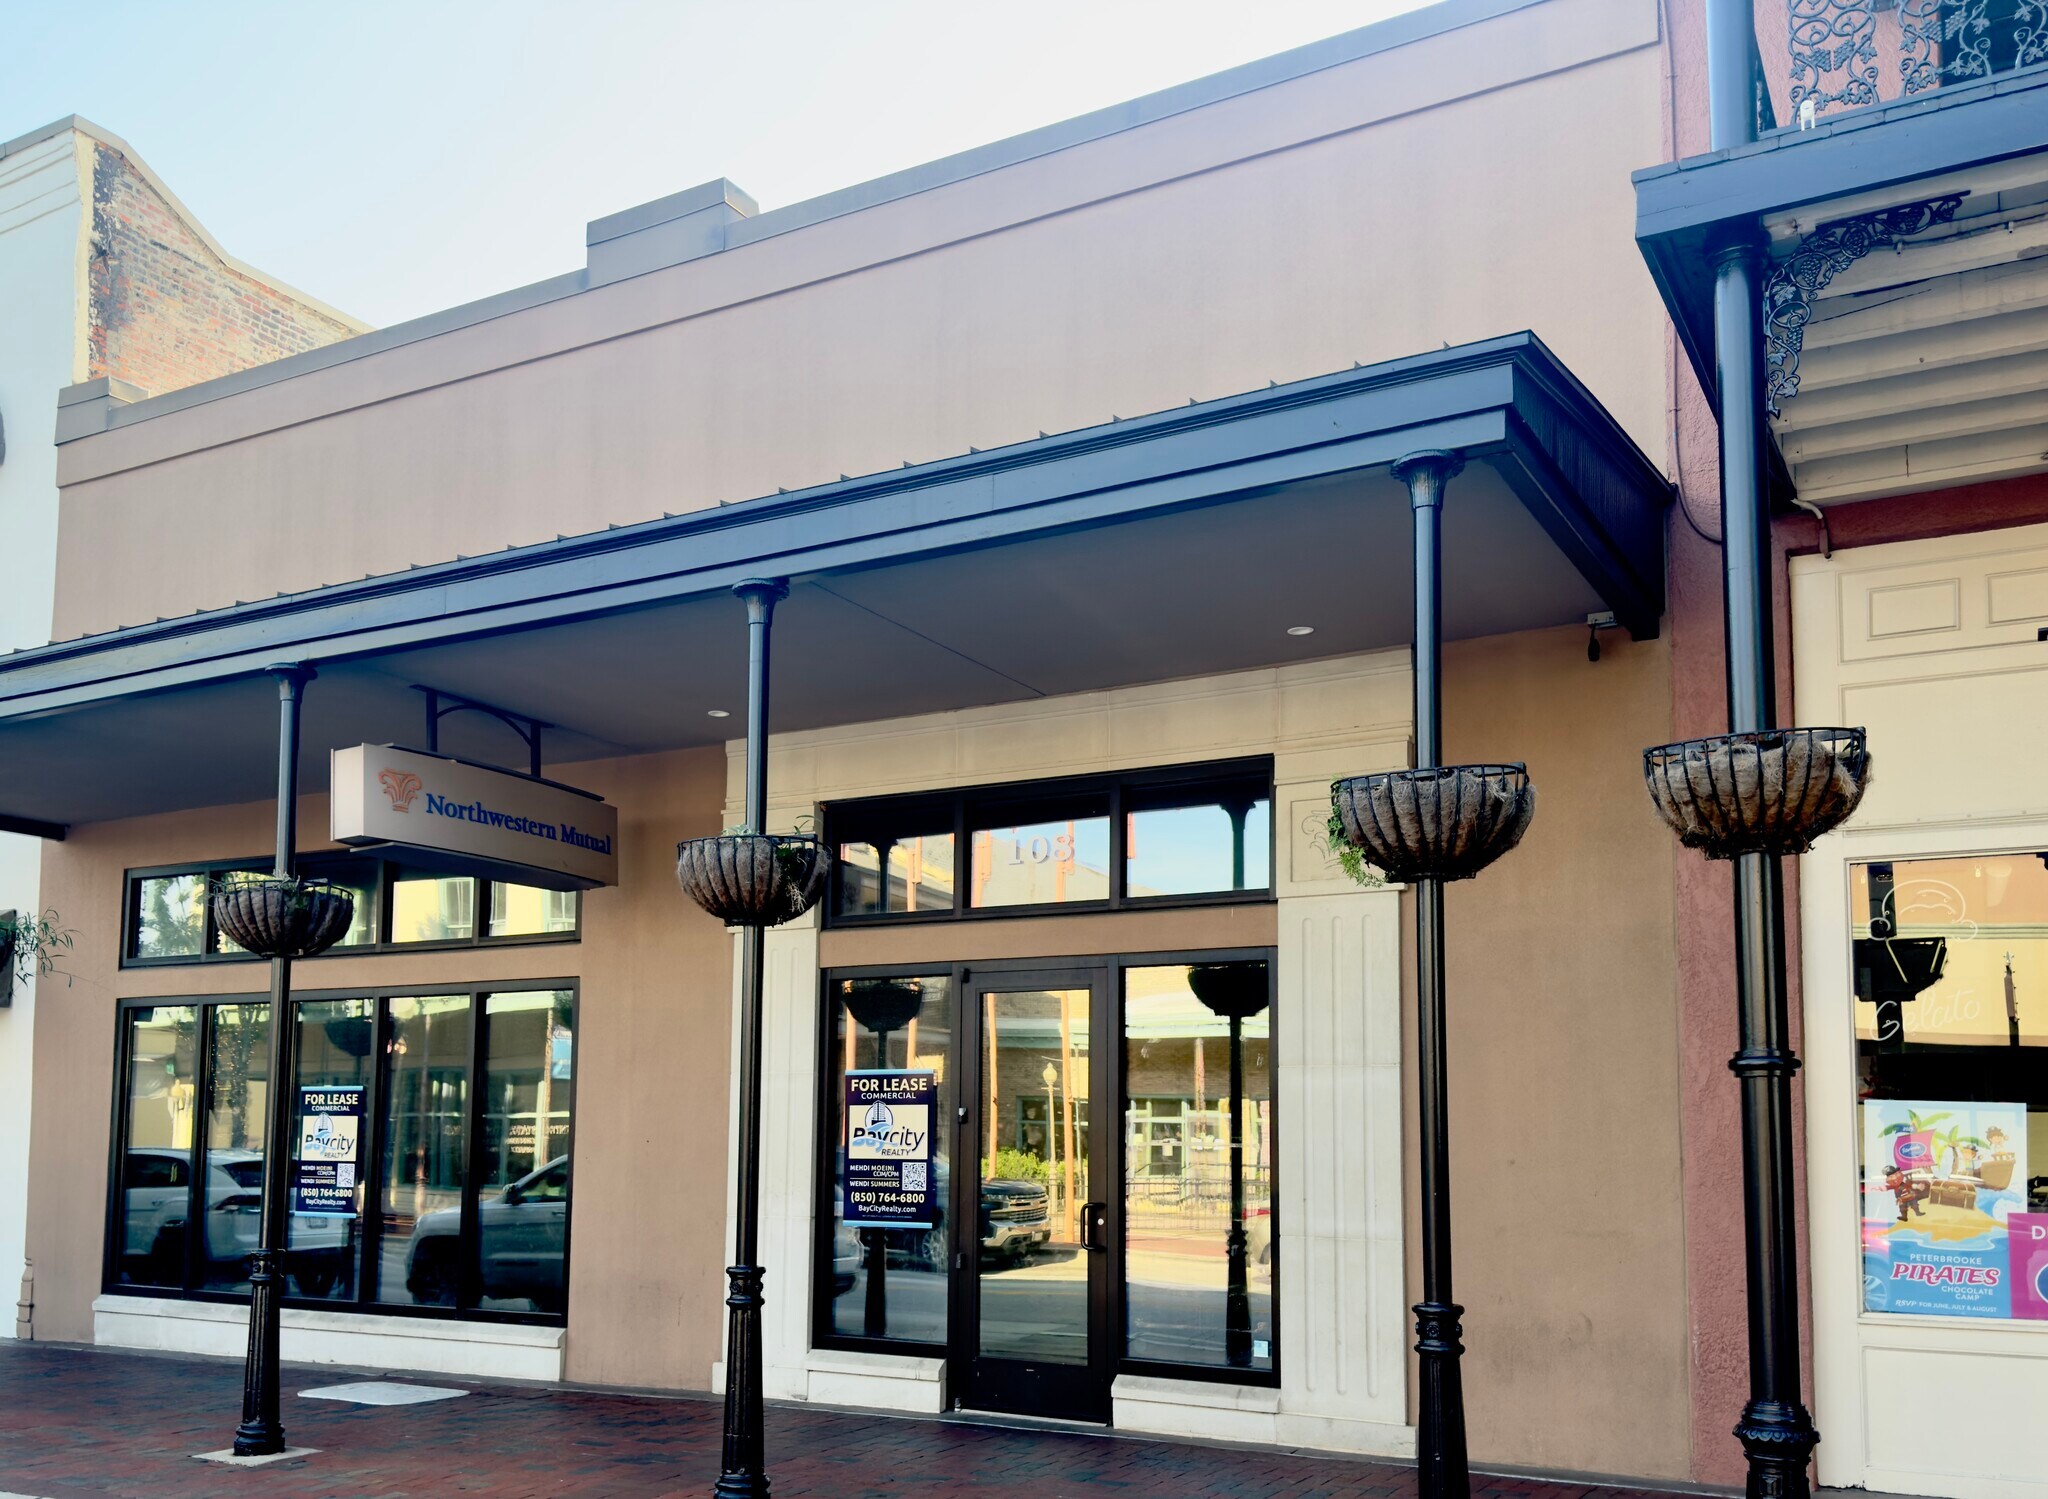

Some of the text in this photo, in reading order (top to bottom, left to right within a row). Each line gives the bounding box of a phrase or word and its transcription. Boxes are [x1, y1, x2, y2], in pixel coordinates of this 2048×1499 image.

[426, 793, 612, 856] Northwestern Mutual
[1008, 832, 1074, 865] 108
[1869, 988, 1980, 1041] Gelato
[851, 1078, 928, 1092] FOR LEASE
[305, 1094, 359, 1105] FOR LEASE
[861, 1092, 917, 1100] COMMERCIAL
[881, 1148, 911, 1156] REALTY
[301, 1187, 353, 1198] (850) 764-6800
[850, 1191, 925, 1204] (850) 764-6800
[858, 1204, 917, 1213] BayCityRealty.com
[2031, 1225, 2048, 1240] D
[1909, 1253, 1982, 1265] PETERBROOKE
[1890, 1262, 2000, 1287] PIRATES
[1941, 1285, 1993, 1296] CHOCOLATE
[1955, 1293, 1980, 1301] CAMP
[1895, 1299, 1917, 1307] RSVP
